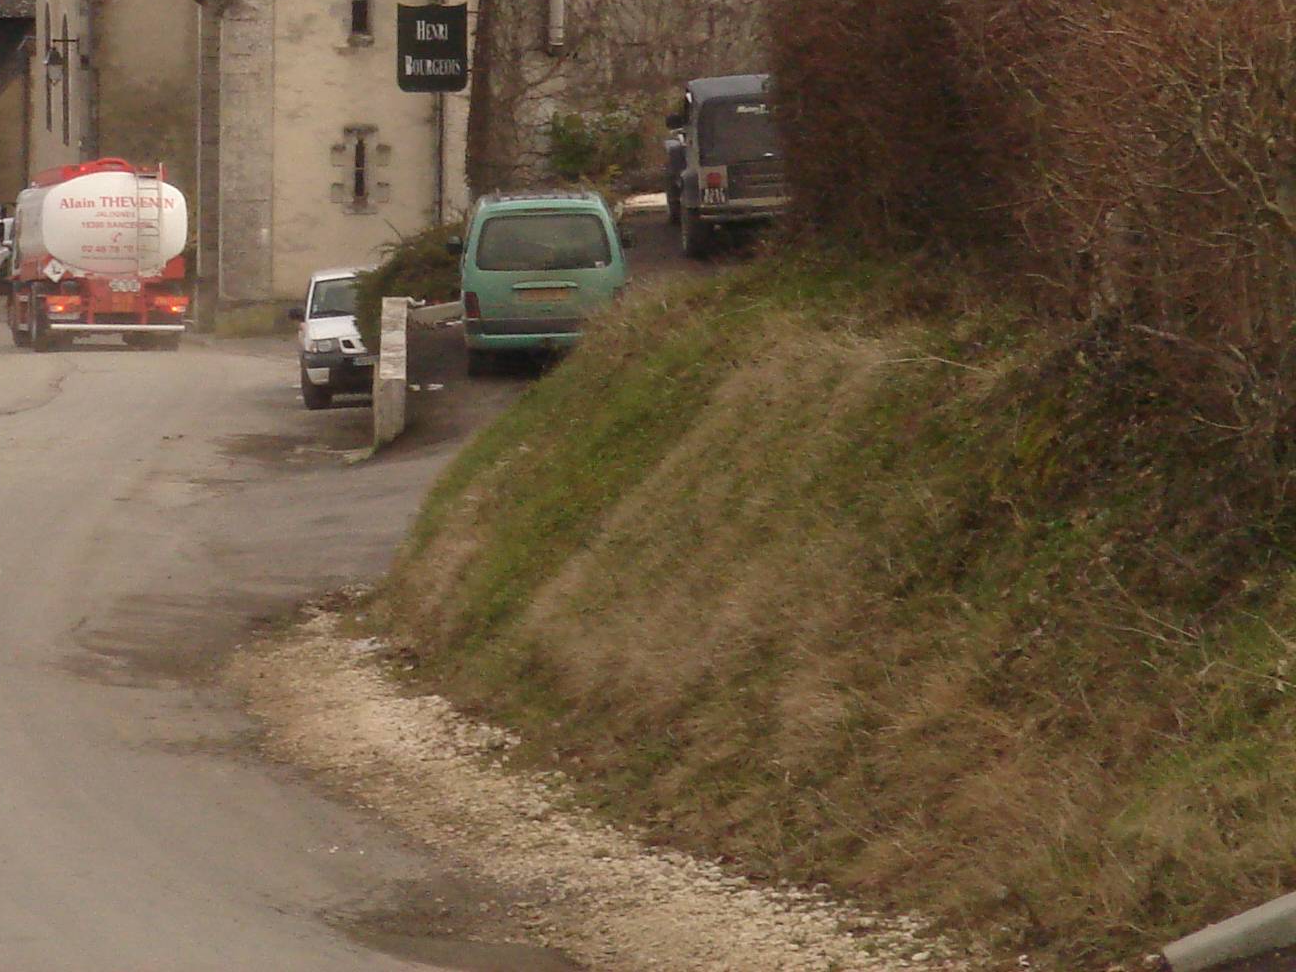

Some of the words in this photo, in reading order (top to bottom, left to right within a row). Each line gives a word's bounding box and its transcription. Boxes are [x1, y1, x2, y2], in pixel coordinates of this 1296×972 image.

[416, 20, 448, 41] HENRI
[405, 55, 462, 76] BOURGEOIS
[60, 197, 95, 209] Alain
[99, 196, 175, 209] THEVENN
